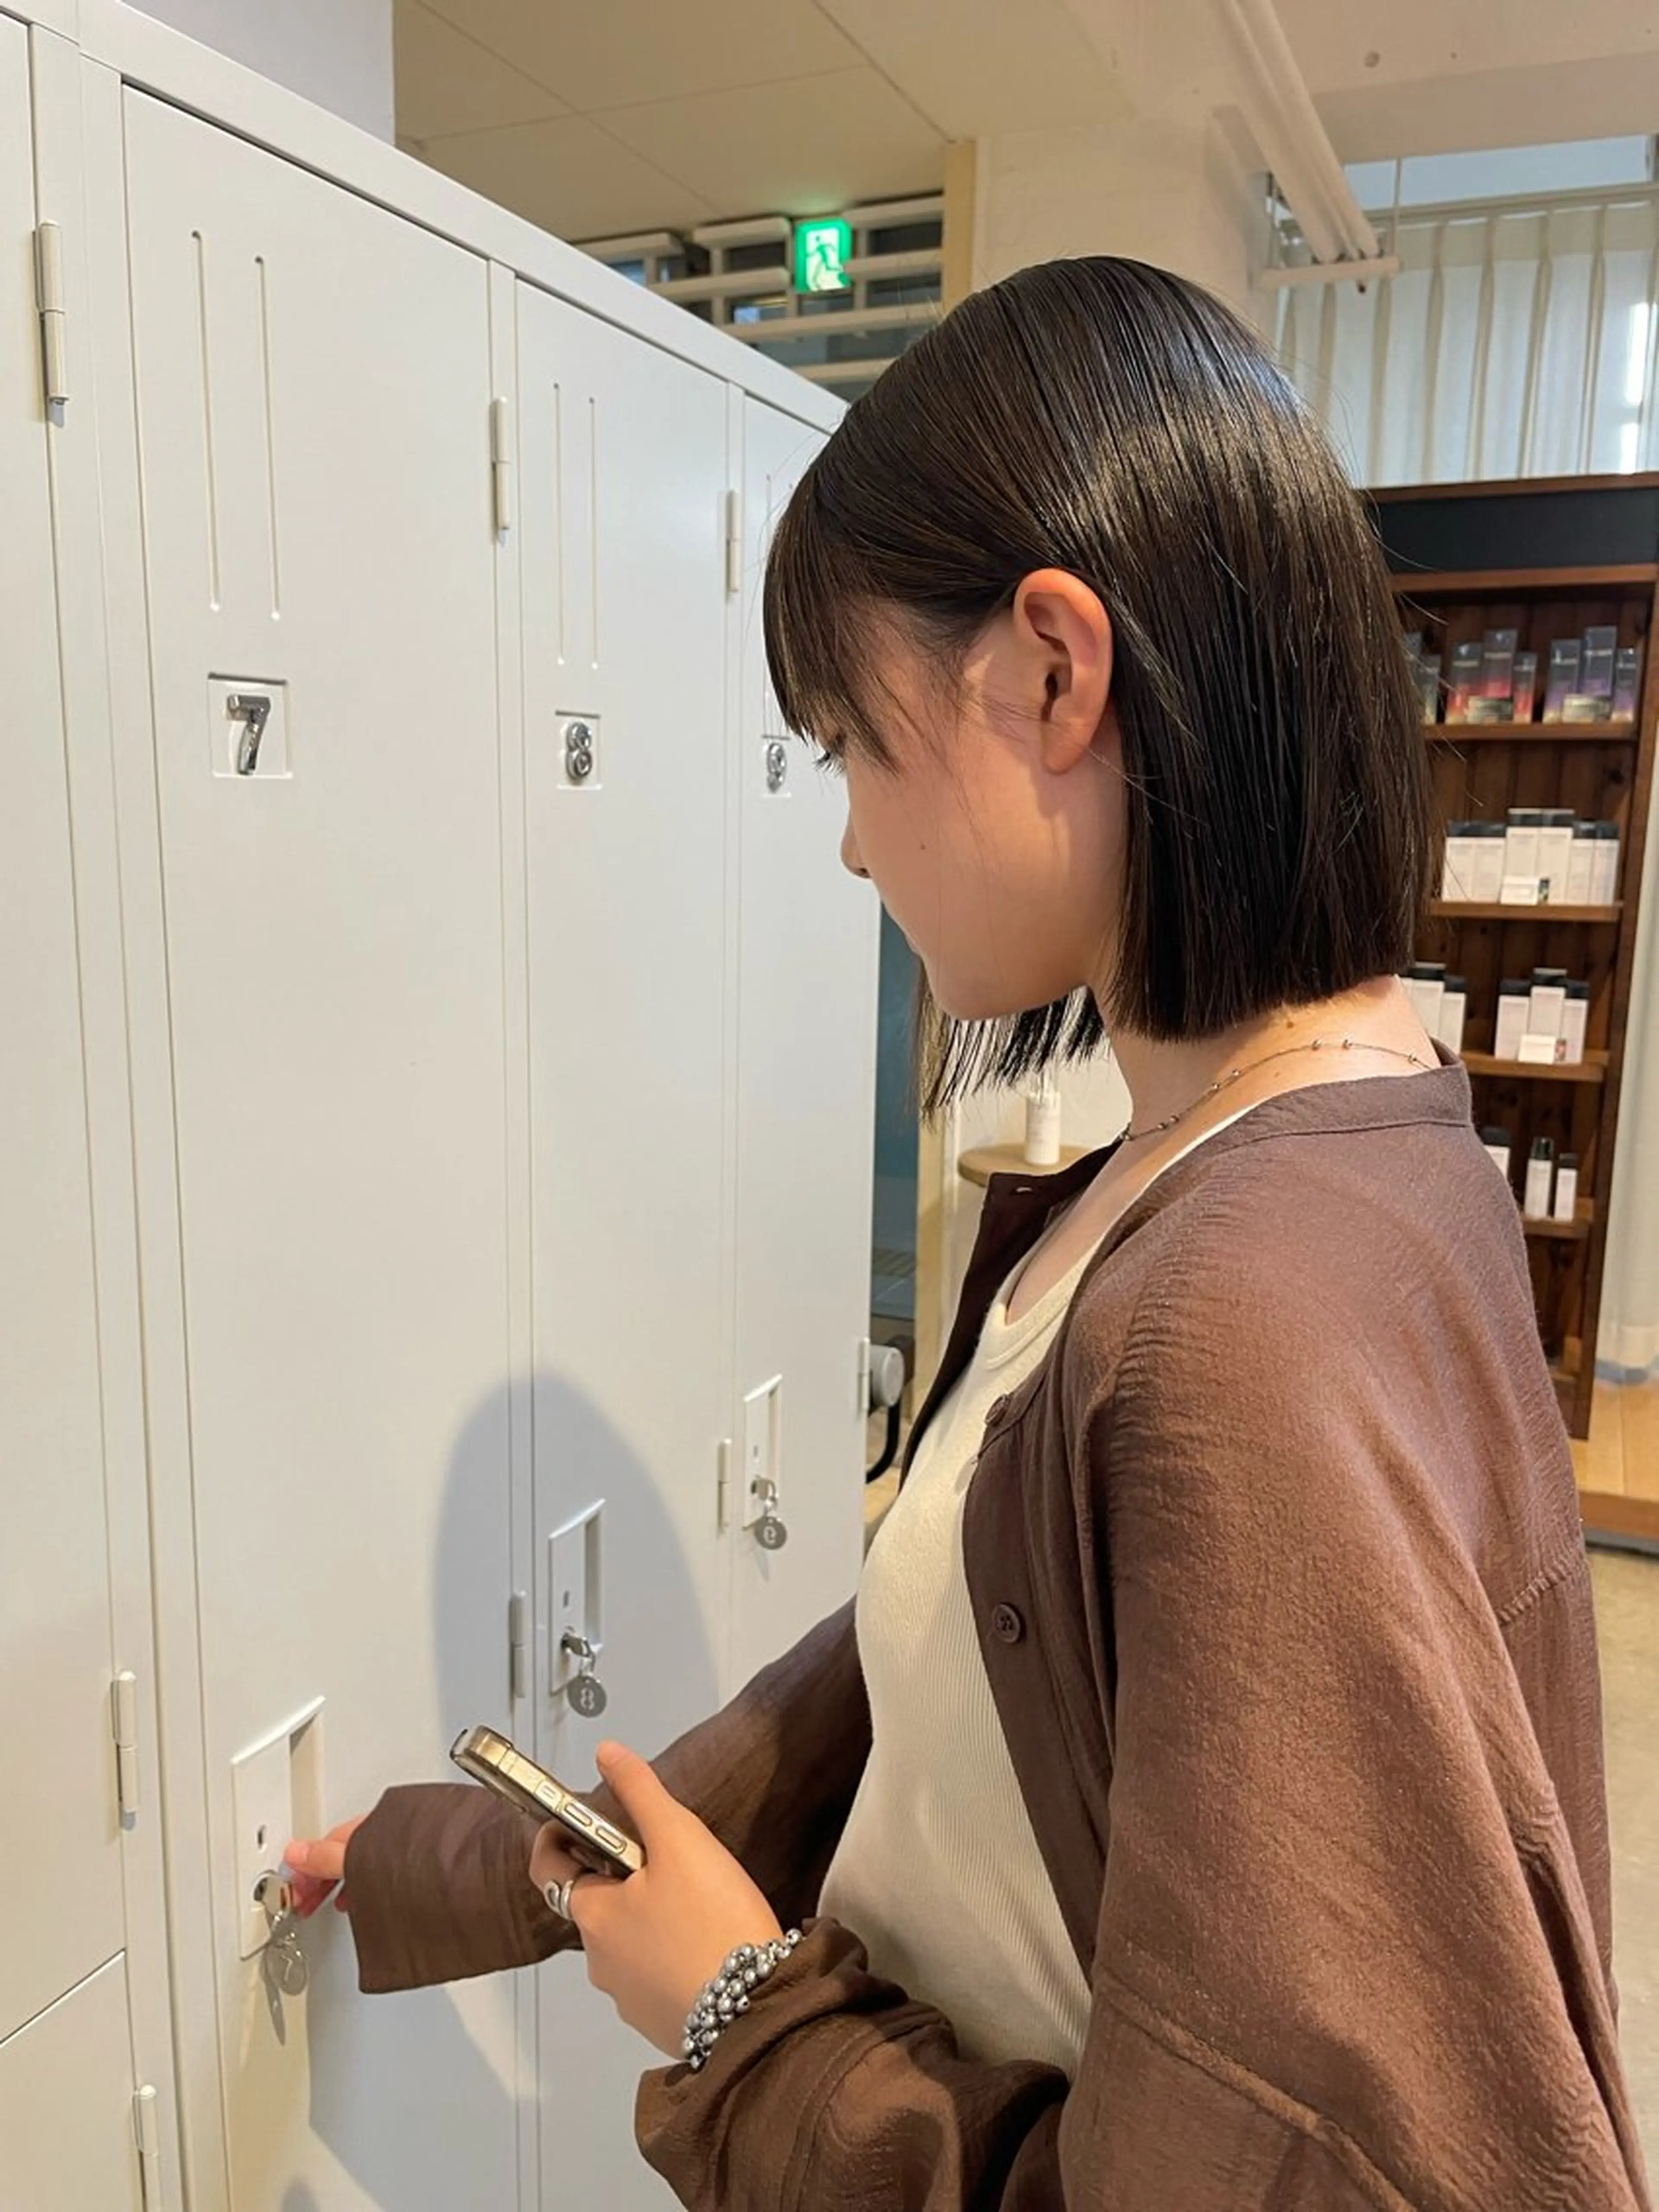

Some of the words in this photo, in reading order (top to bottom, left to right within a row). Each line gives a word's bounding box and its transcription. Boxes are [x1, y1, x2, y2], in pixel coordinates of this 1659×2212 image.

[227, 694, 271, 775] 7
[566, 722, 592, 780] 8
[767, 742, 787, 793] 9
[580, 1687, 595, 1710] 8
[281, 1954, 293, 1982] 7
